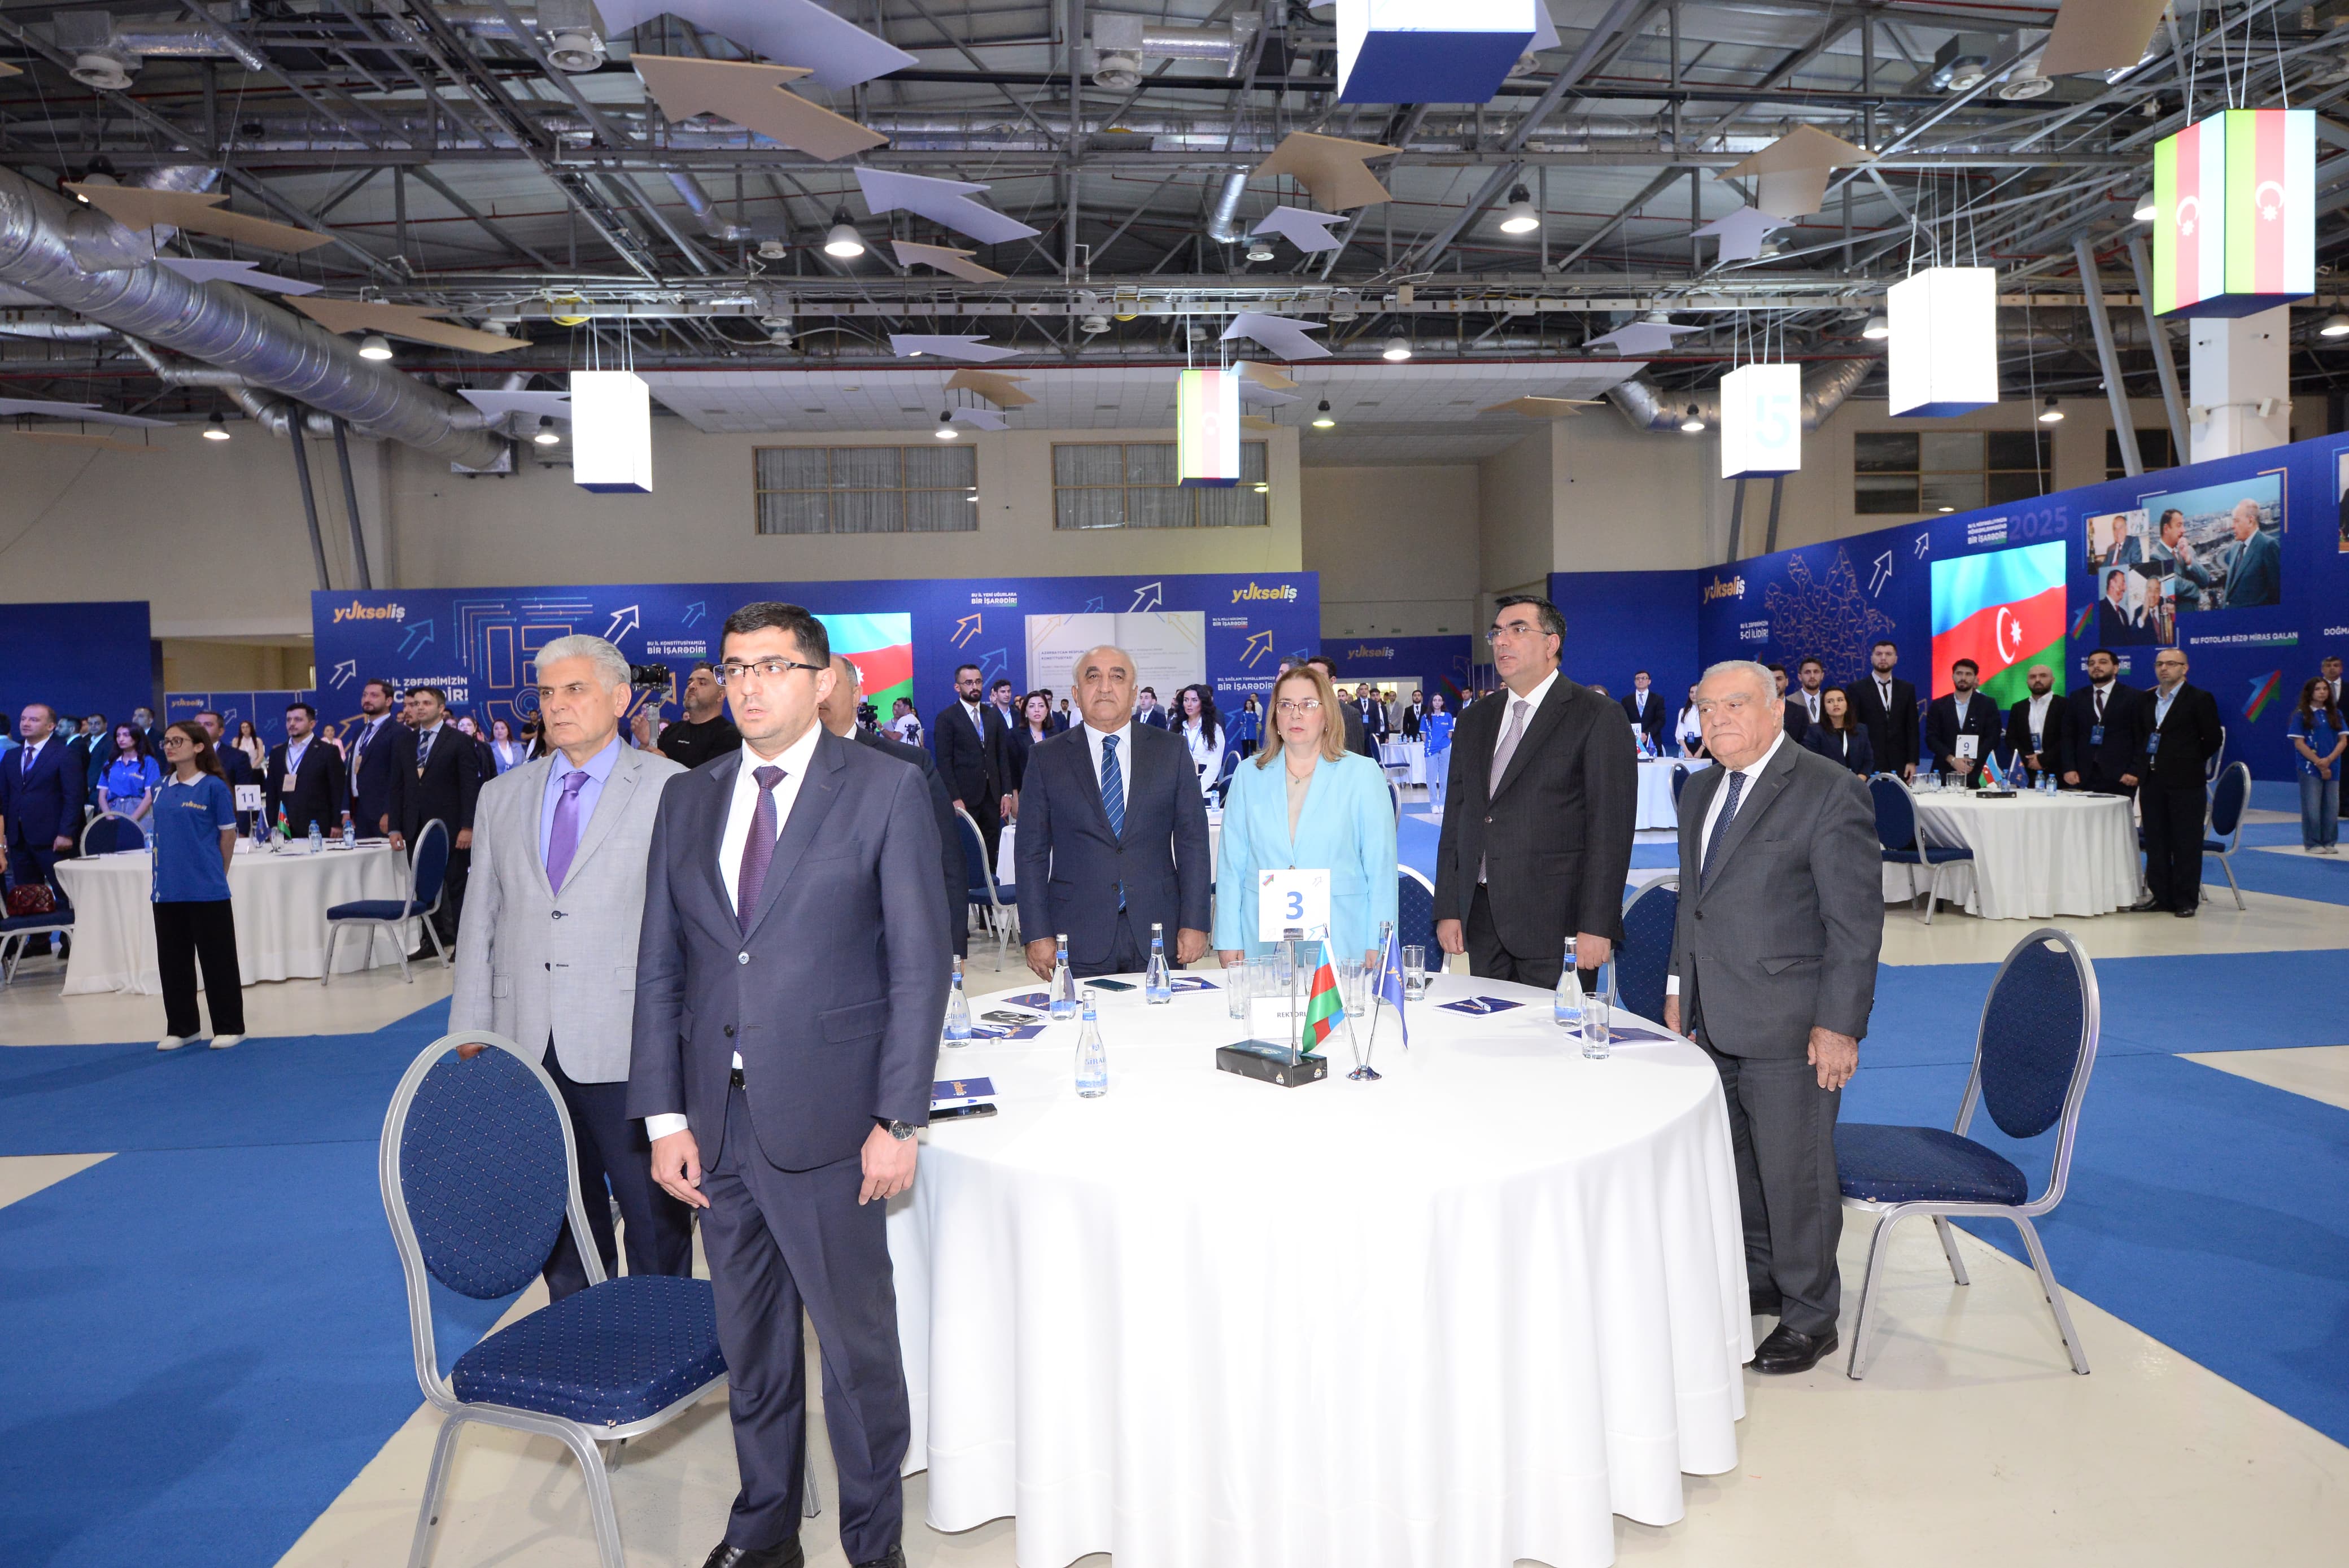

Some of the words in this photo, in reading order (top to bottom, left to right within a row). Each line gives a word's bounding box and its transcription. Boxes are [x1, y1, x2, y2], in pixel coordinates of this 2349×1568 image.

[2010, 506, 2068, 540] 2025
[2200, 635, 2231, 644] FOTOLAR
[2232, 634, 2248, 642] BİZƏ
[2249, 632, 2271, 641] MİRAS
[2272, 631, 2298, 640] QALAN
[663, 645, 706, 655] İŞARƏDİR!
[404, 676, 468, 686] ZƏFƏRİMİZİN
[1963, 742, 1970, 751] 9
[241, 793, 254, 803] 11
[1286, 892, 1303, 919] 3
